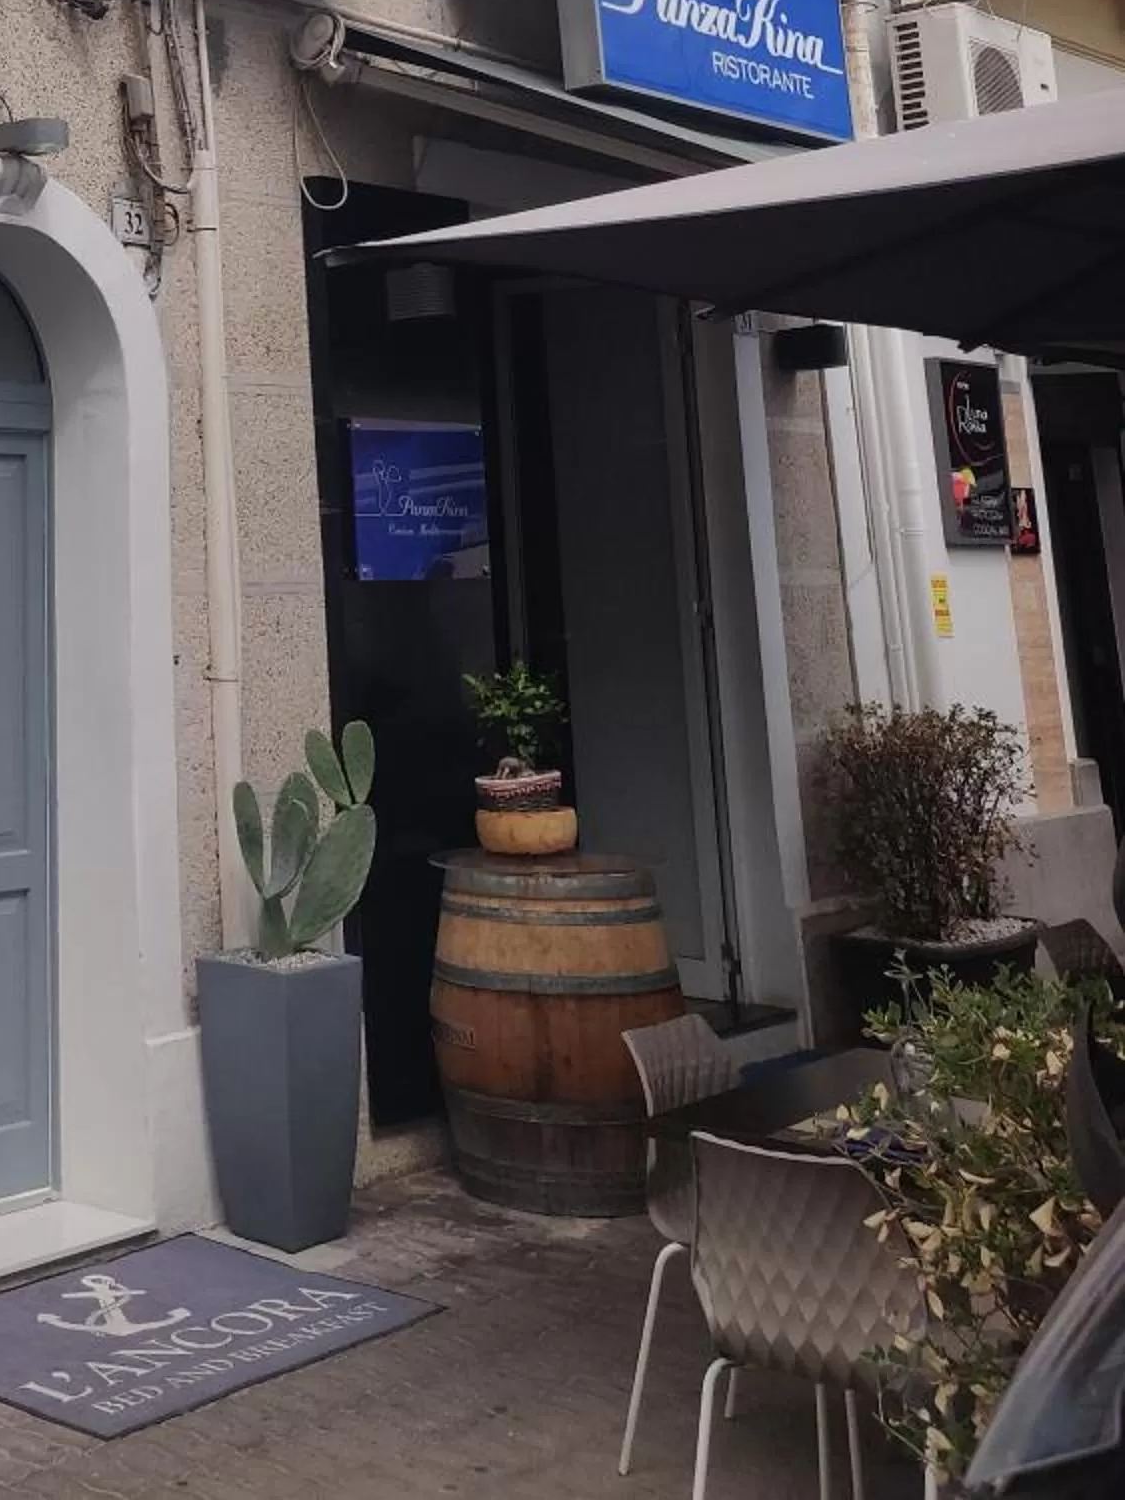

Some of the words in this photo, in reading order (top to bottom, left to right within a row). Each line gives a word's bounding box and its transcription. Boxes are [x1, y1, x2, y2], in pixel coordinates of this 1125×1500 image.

[712, 51, 815, 99] RISTORANTE
[20, 1284, 363, 1404] L'ANCORA
[91, 1384, 164, 1416] BED
[165, 1357, 235, 1390] AND
[235, 1299, 390, 1366] BREAKFAST
